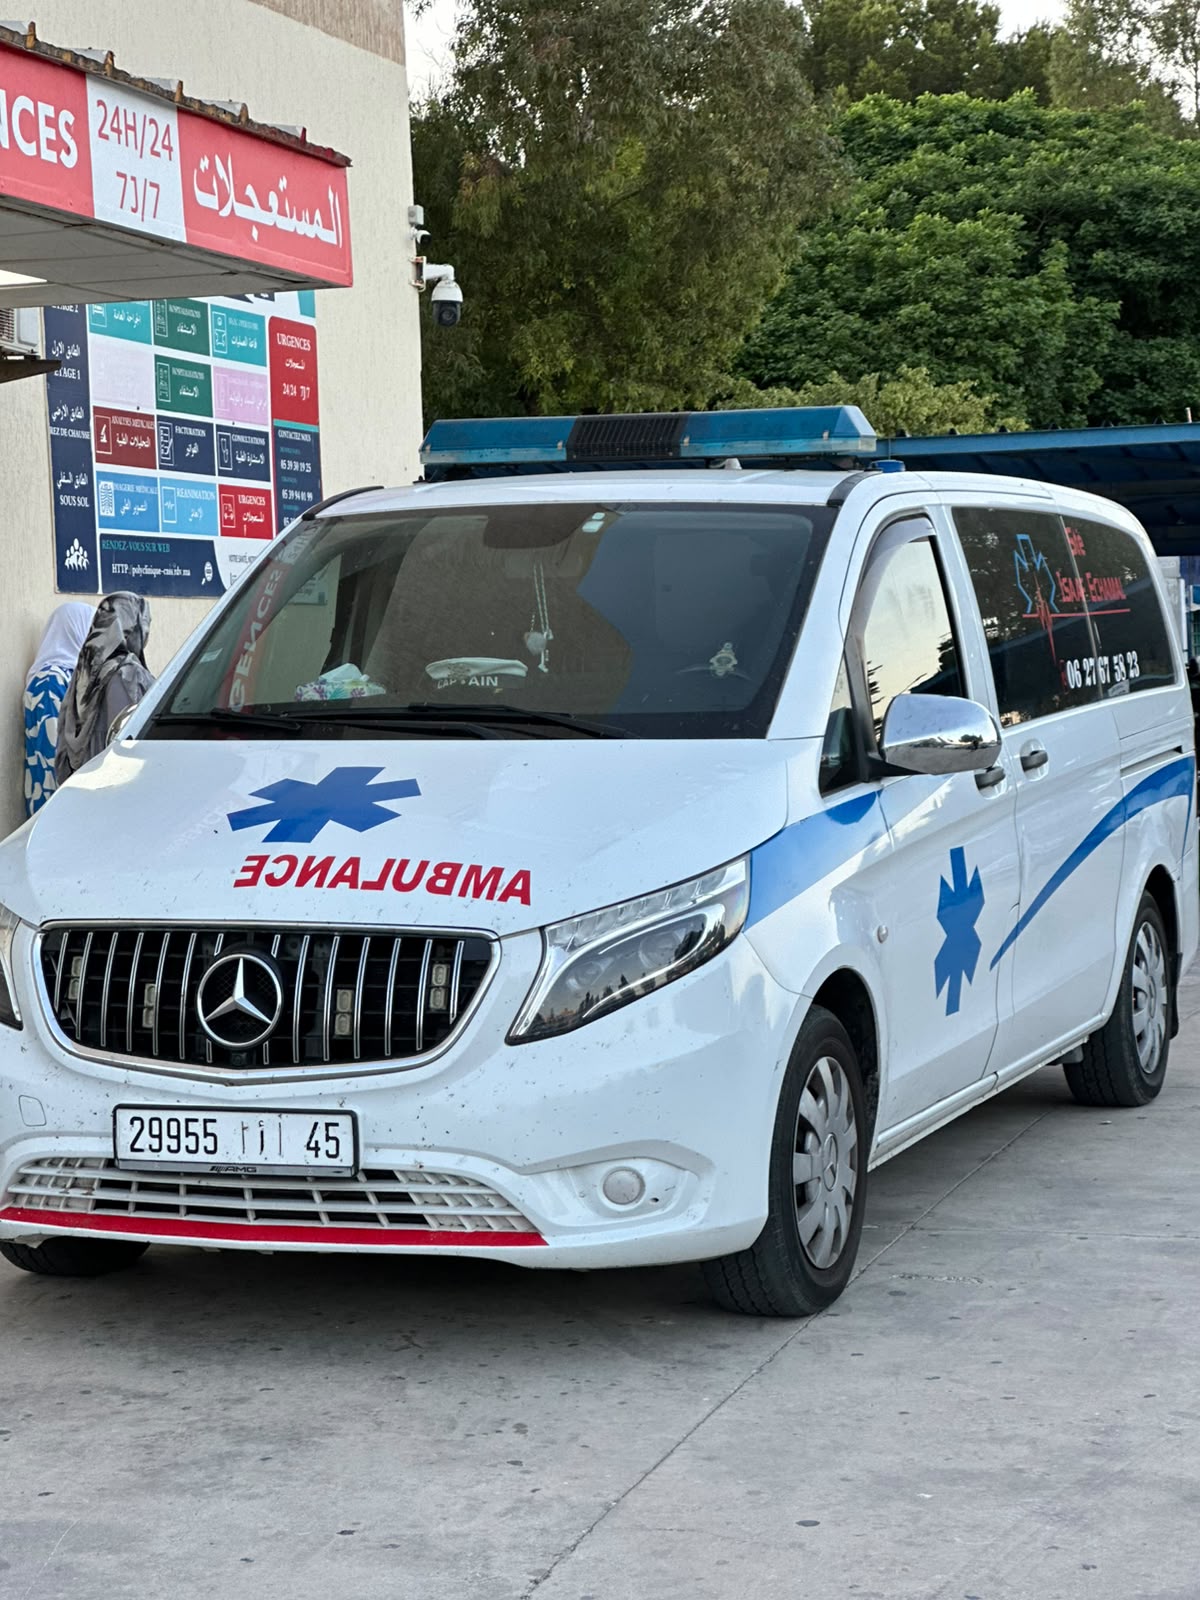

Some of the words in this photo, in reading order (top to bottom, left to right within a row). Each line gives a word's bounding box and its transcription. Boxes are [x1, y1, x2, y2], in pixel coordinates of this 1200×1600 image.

[96, 99, 173, 161] 24H/24
[115, 171, 160, 222] 7J/7
[193, 152, 342, 248] المستعجلات
[277, 332, 311, 351] URGENCES
[175, 425, 206, 437] FACTURATION
[59, 494, 76, 506] SOUS
[77, 496, 90, 507] SOL
[237, 494, 266, 506] URGENCES
[437, 675, 498, 689] CAPAIN
[1066, 659, 1082, 690] 06
[1082, 657, 1097, 687] 27
[1097, 655, 1111, 685] 67
[1113, 653, 1127, 682] 58
[1126, 650, 1140, 679] 23
[129, 1116, 218, 1156] 29955
[305, 1121, 340, 1159] 45
